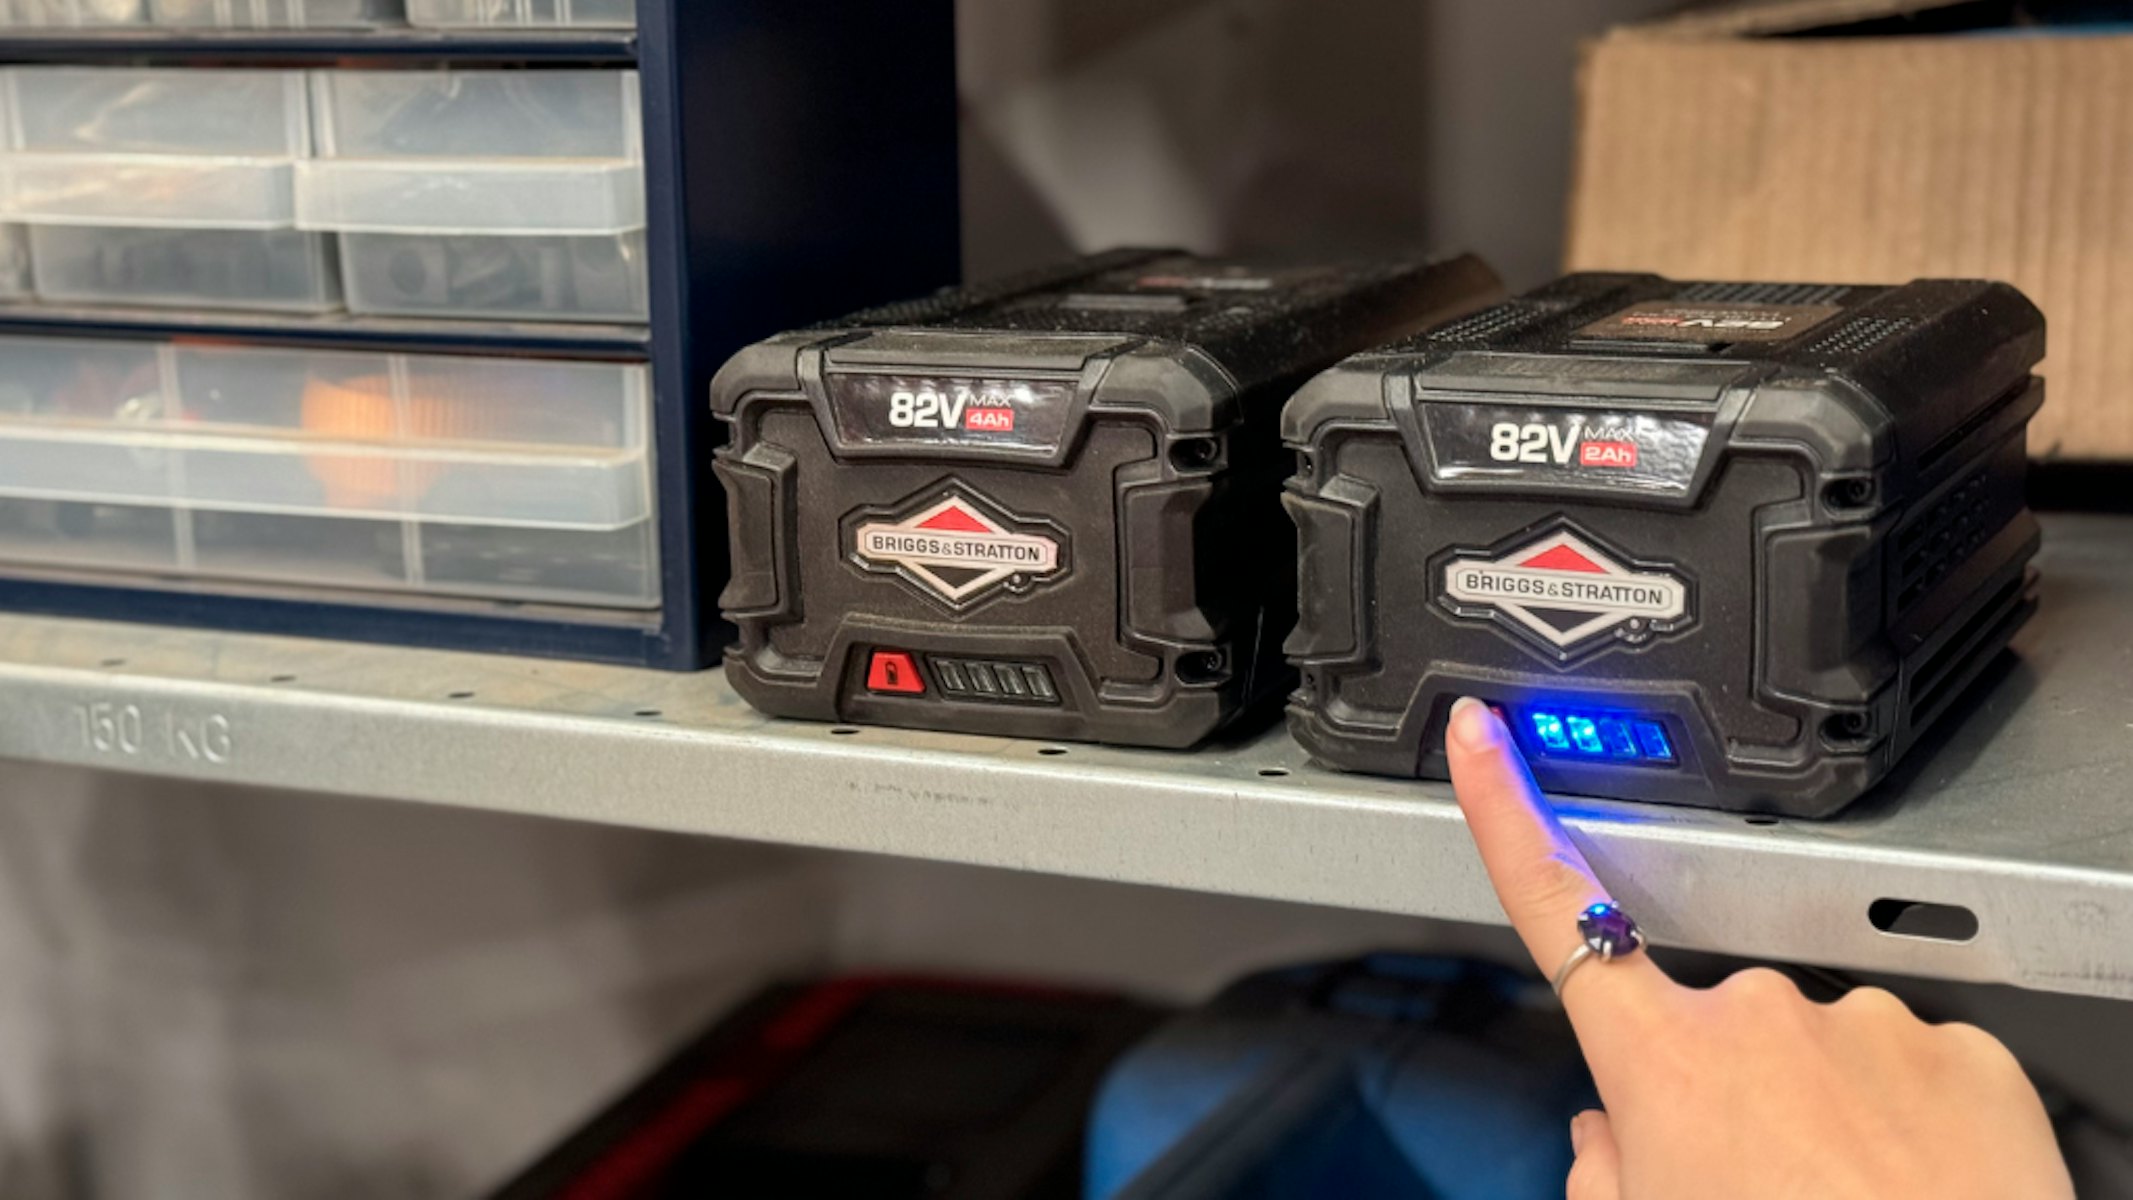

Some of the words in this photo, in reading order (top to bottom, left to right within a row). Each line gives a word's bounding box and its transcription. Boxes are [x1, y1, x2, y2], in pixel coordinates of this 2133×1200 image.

[889, 391, 968, 429] 82V
[969, 394, 1012, 408] MAX
[968, 412, 1010, 428] 4Ah
[1490, 422, 1581, 465] 82V
[1584, 426, 1634, 442] MAX
[1584, 446, 1633, 463] 2Ah
[73, 702, 143, 755] 150
